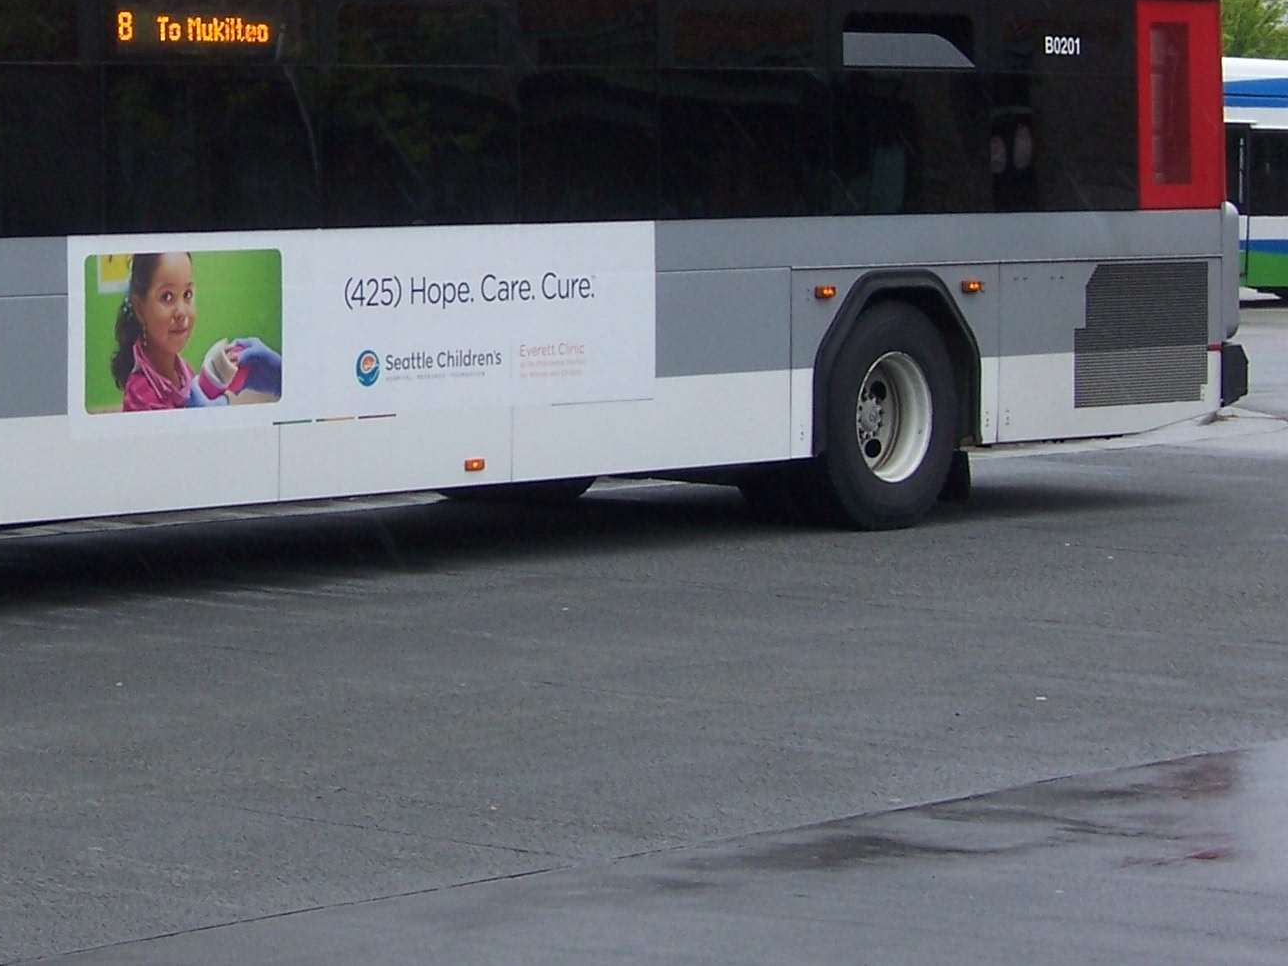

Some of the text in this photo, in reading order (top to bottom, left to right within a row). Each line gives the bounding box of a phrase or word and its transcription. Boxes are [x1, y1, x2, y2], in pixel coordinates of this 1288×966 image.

[117, 11, 269, 42] 8 To Mukilteo
[1044, 36, 1081, 55] B0201
[344, 271, 596, 309] (425) Hope. Care. Cure.
[385, 351, 434, 371] Seattle
[436, 348, 503, 369] Children's
[519, 341, 586, 357] Everett Clinic
